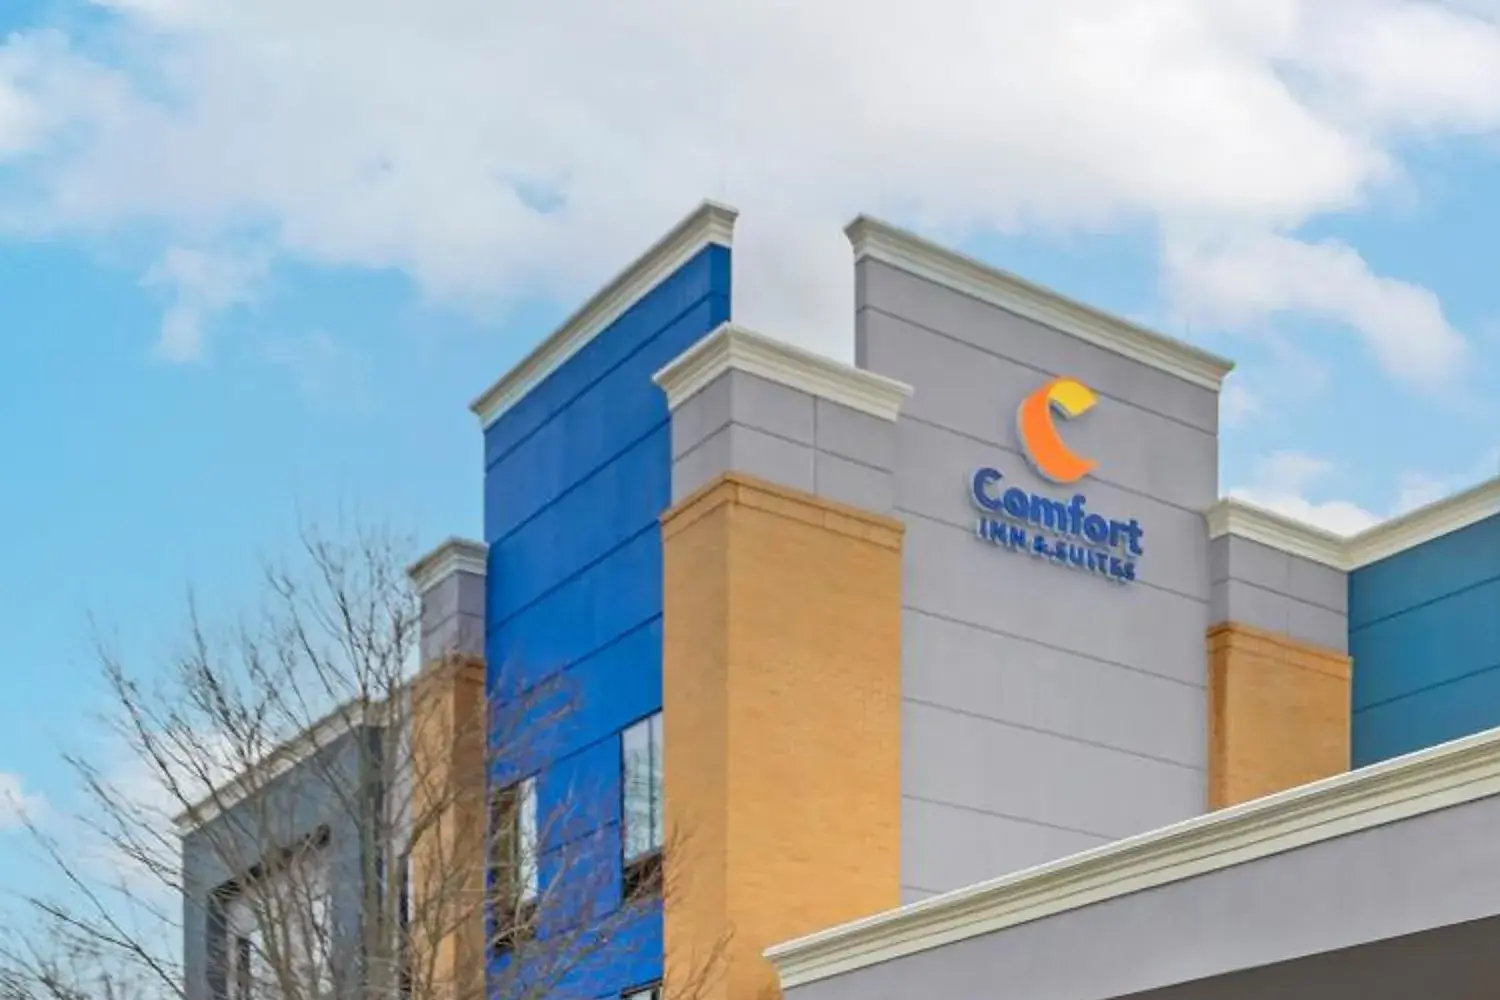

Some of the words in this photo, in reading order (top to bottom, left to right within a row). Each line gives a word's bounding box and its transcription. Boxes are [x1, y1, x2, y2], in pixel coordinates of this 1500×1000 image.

[971, 466, 1143, 556] Comfort
[977, 515, 1027, 550] INN
[1031, 535, 1053, 557] &
[1055, 540, 1136, 583] SUITES
